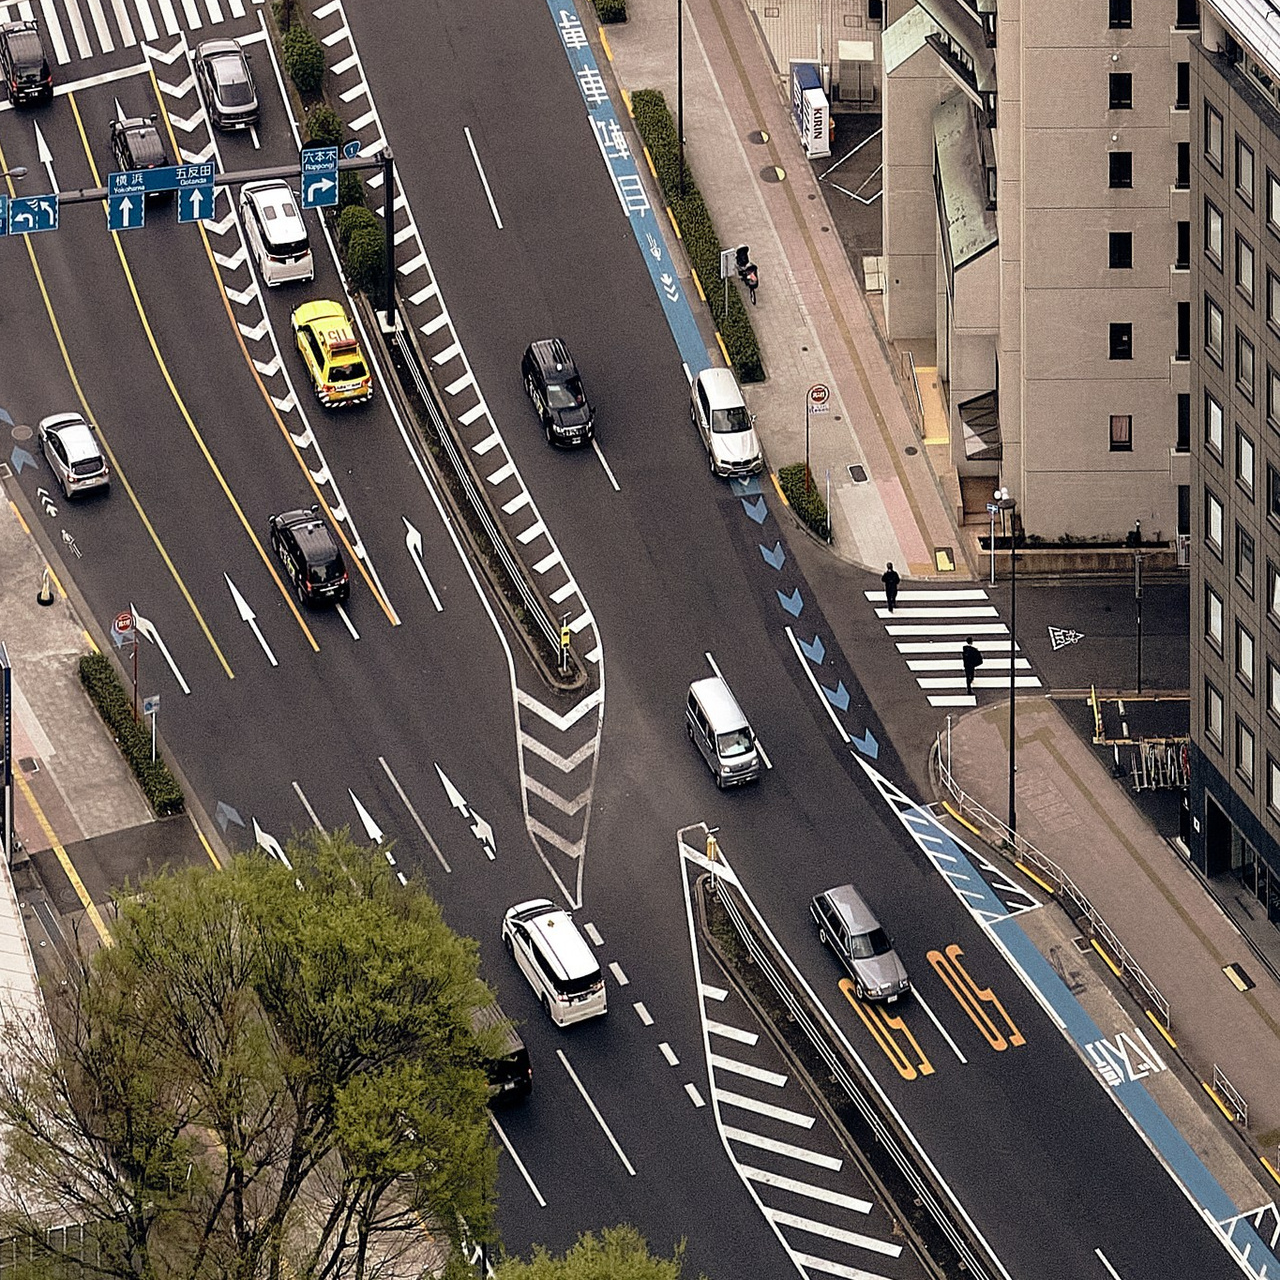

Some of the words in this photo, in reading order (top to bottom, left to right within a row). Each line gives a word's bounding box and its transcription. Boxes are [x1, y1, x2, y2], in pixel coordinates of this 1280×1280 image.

[813, 108, 823, 140] KIRIN
[303, 150, 337, 163] 六本木
[115, 172, 144, 187] 横浜
[175, 165, 212, 180] 五反田
[113, 184, 146, 194] Yokohama
